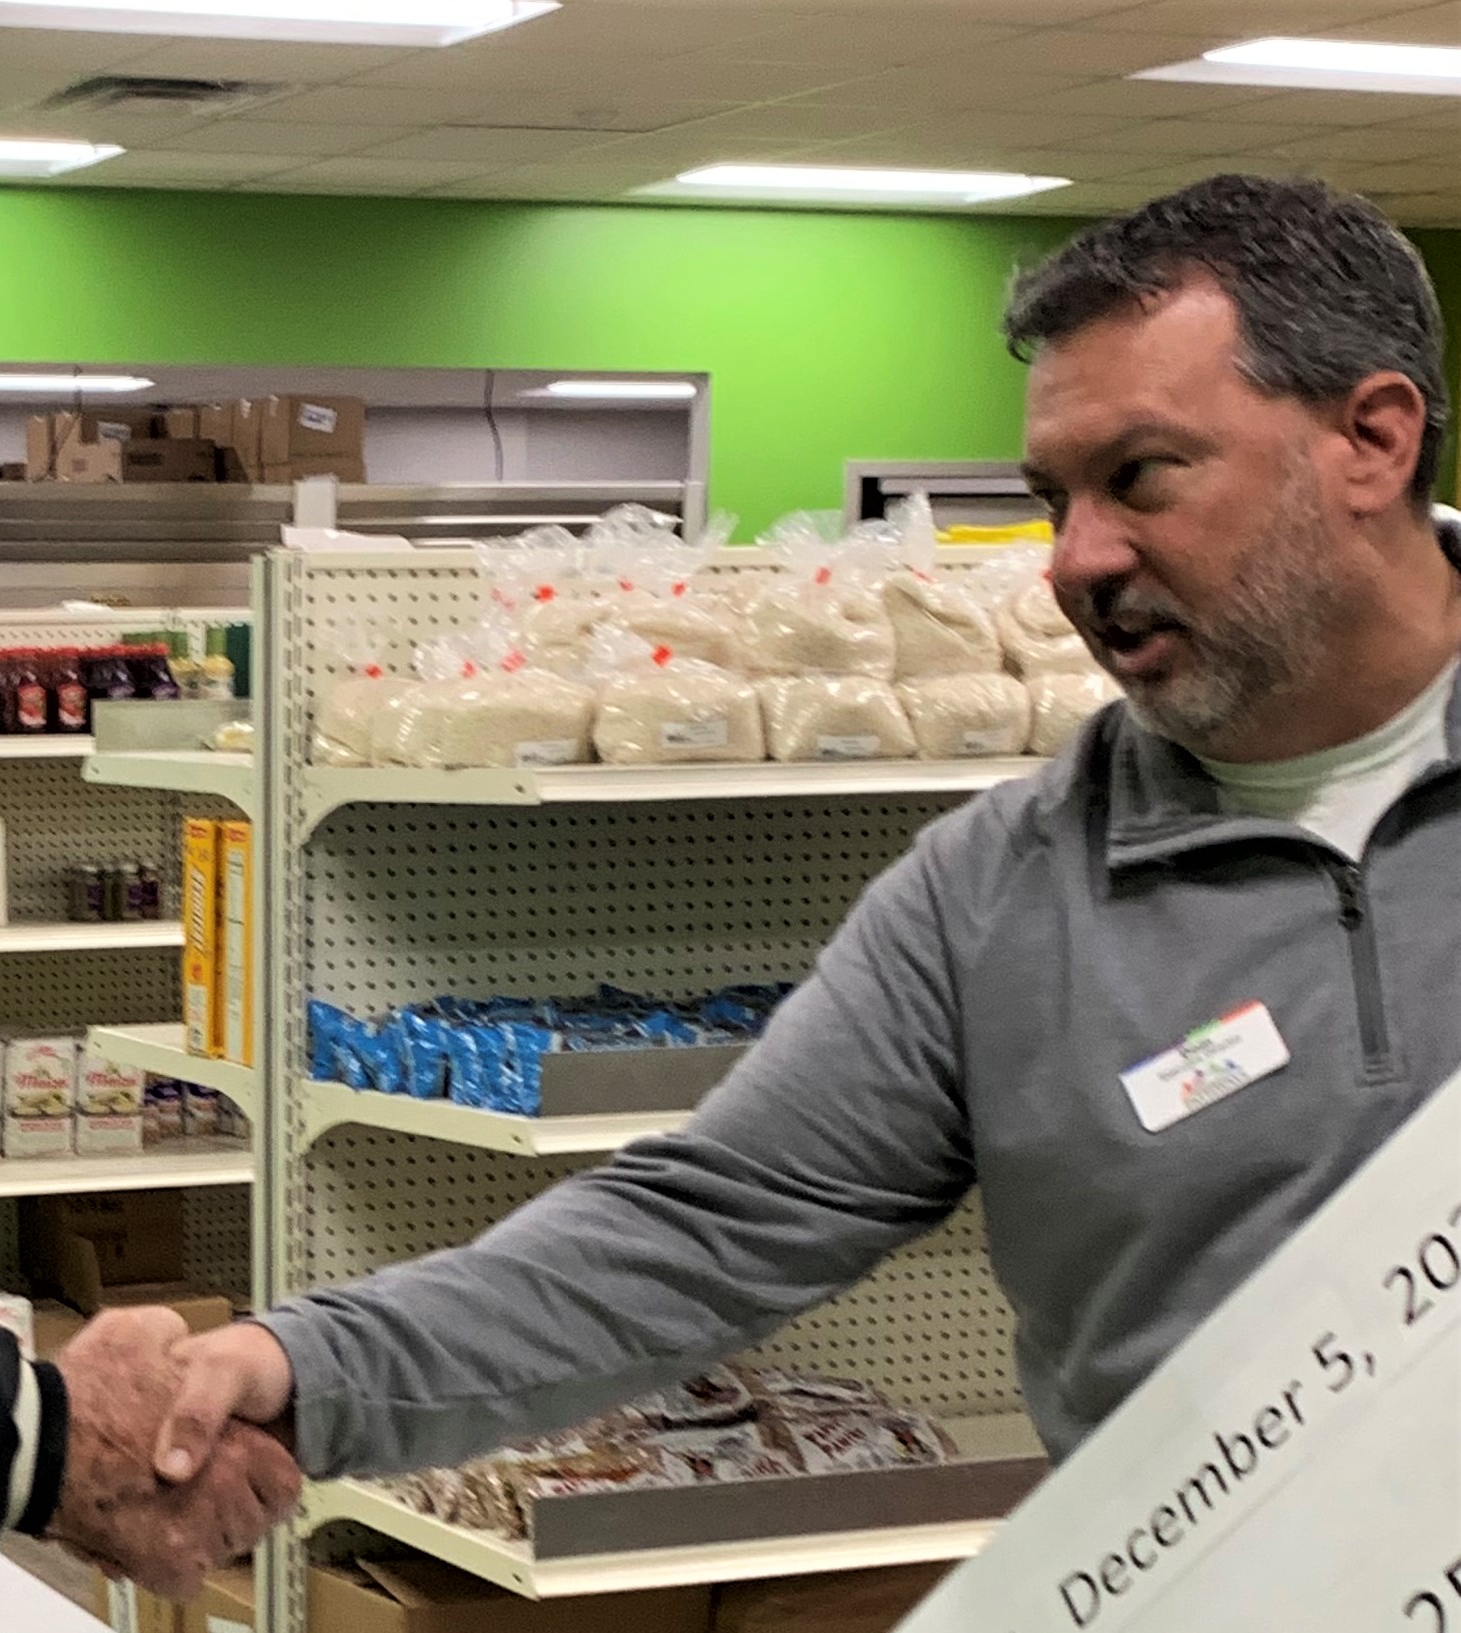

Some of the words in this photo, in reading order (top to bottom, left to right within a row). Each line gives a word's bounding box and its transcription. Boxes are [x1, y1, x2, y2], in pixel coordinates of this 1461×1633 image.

[1057, 1379, 1307, 1630] December
[1312, 1331, 1376, 1394] 5,
[1383, 1203, 1461, 1326] 20
